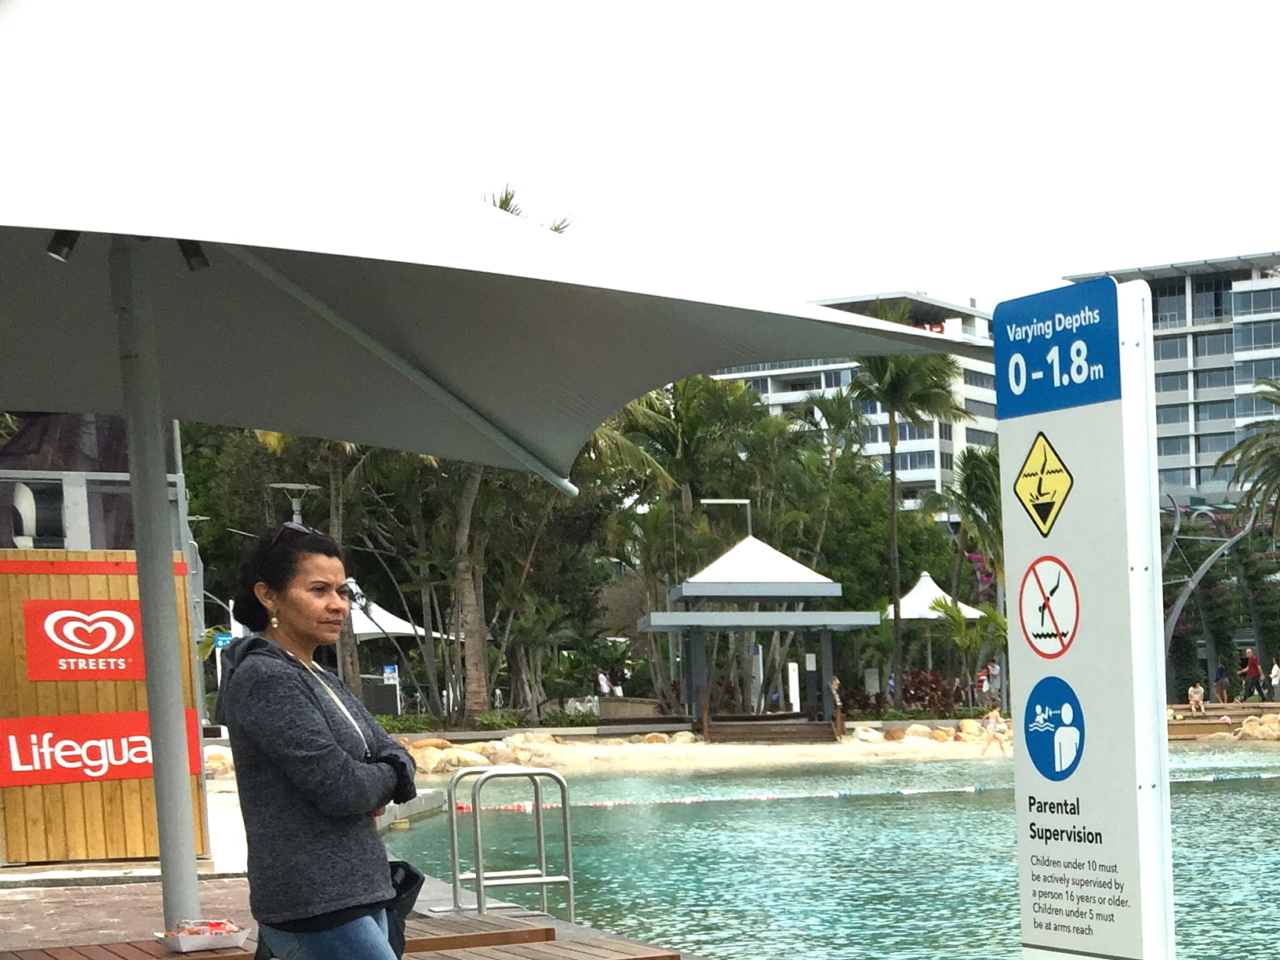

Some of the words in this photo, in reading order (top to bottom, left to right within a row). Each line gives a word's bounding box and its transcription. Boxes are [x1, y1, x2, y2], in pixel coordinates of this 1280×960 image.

[1006, 318, 1053, 343] Varying
[1055, 306, 1100, 333] Depths
[58, 658, 127, 670] STREETS
[1028, 796, 1080, 816] Parental
[1029, 822, 1103, 845] Supervision
[1030, 854, 1062, 869] Children
[1063, 858, 1086, 870] under
[1087, 860, 1097, 871] 10
[1098, 863, 1118, 873] must
[1031, 871, 1041, 882] be
[1042, 873, 1070, 888] actively
[1071, 877, 1112, 889] supervised
[1114, 878, 1125, 893] by
[1032, 889, 1037, 897] a
[1038, 889, 1063, 900] person
[1065, 891, 1075, 902] 16
[1076, 894, 1096, 905] years
[1097, 896, 1106, 905] or
[1107, 895, 1131, 908] older.
[1032, 902, 1064, 916] Children
[1065, 906, 1087, 919] under
[1088, 909, 1094, 920] 5
[1095, 912, 1115, 923] must
[1033, 917, 1043, 929] be
[1044, 921, 1052, 931] at
[1053, 923, 1072, 933] arms
[1072, 924, 1094, 936] reach
